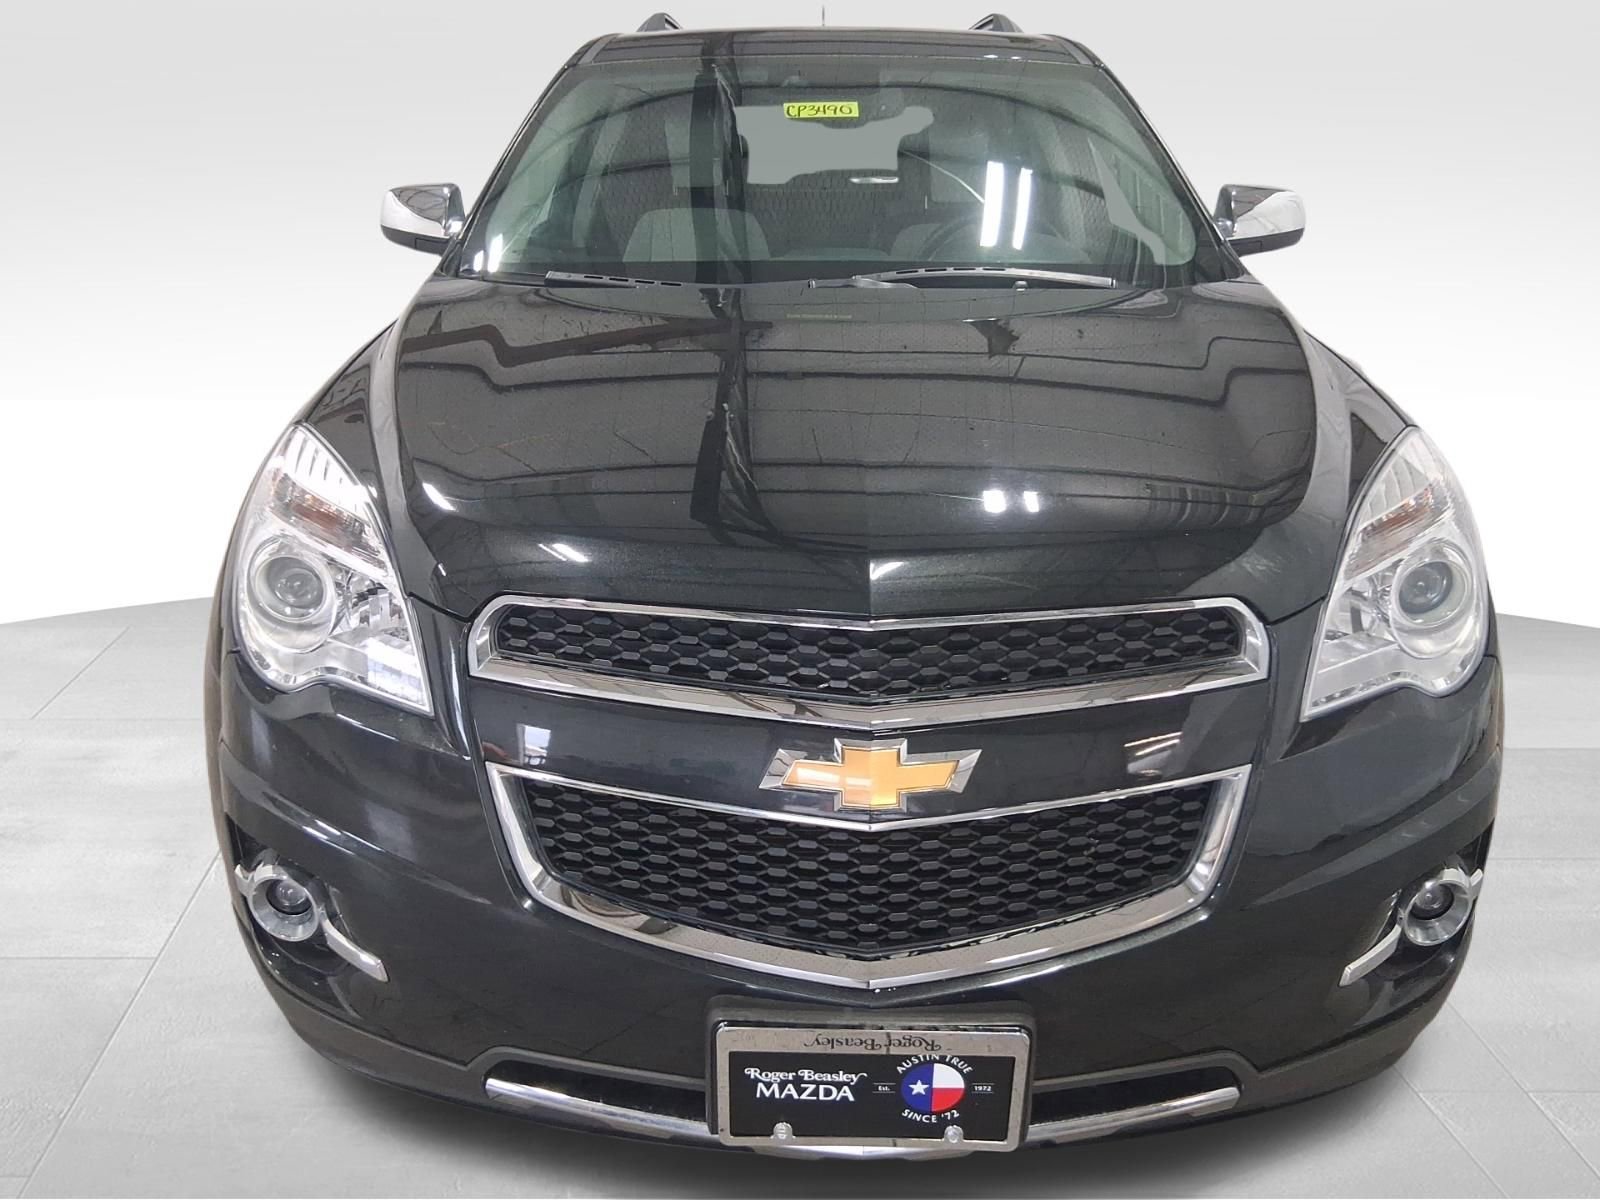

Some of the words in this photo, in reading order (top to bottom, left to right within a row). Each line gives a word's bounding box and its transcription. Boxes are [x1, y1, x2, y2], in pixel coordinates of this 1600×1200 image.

[803, 1033, 883, 1051] Beasley
[885, 1034, 942, 1052] Roger
[896, 1053, 940, 1074] AUSTIN
[945, 1054, 974, 1075] TRUE
[744, 1067, 797, 1083] Roger
[797, 1069, 868, 1085] Beasley
[755, 1082, 856, 1102] MAZDA
[901, 1108, 938, 1124] SINCE
[940, 1109, 961, 1121] '72
